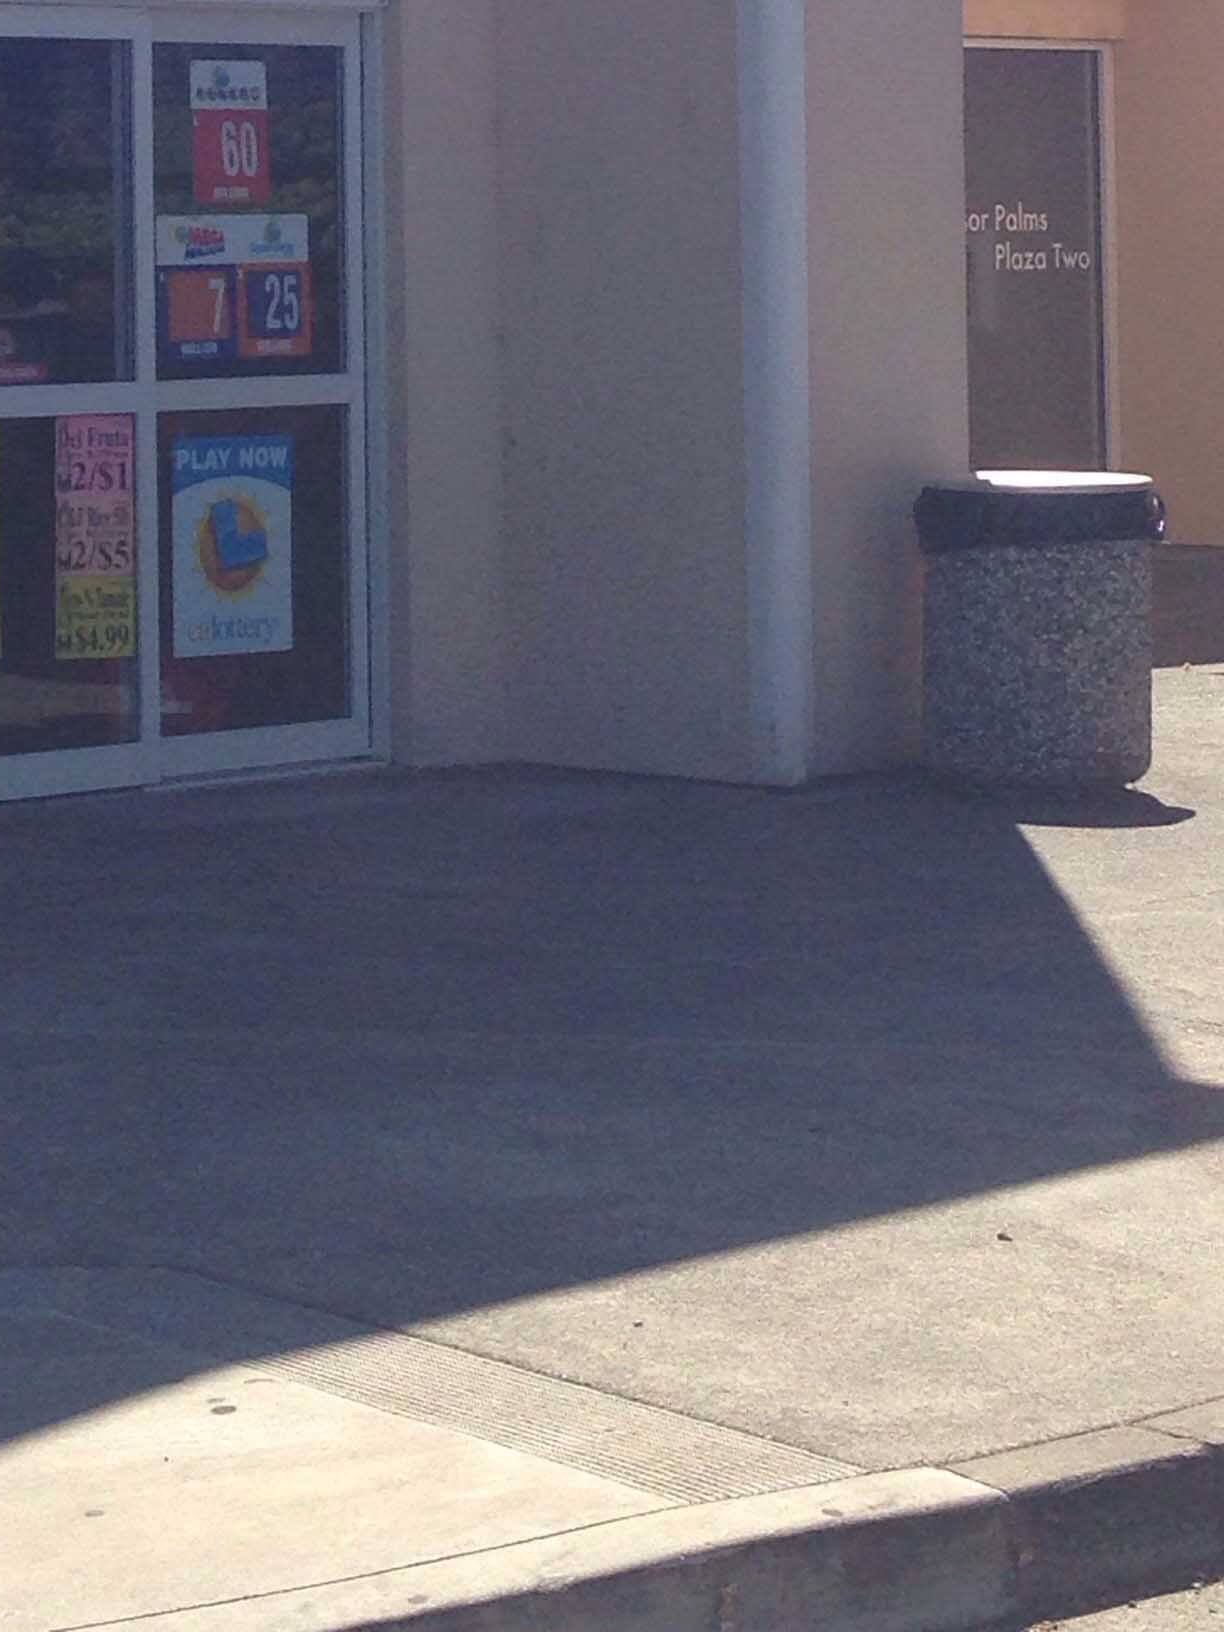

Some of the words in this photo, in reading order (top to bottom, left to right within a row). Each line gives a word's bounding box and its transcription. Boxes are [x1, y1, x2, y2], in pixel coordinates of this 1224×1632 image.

[221, 120, 258, 177] 60
[962, 213, 989, 231] or
[995, 201, 1048, 231] Palms
[995, 241, 1047, 270] Plaza
[1052, 243, 1091, 269] Two
[264, 272, 299, 330] 25
[177, 446, 231, 471] PLAY
[239, 446, 288, 470] NOW
